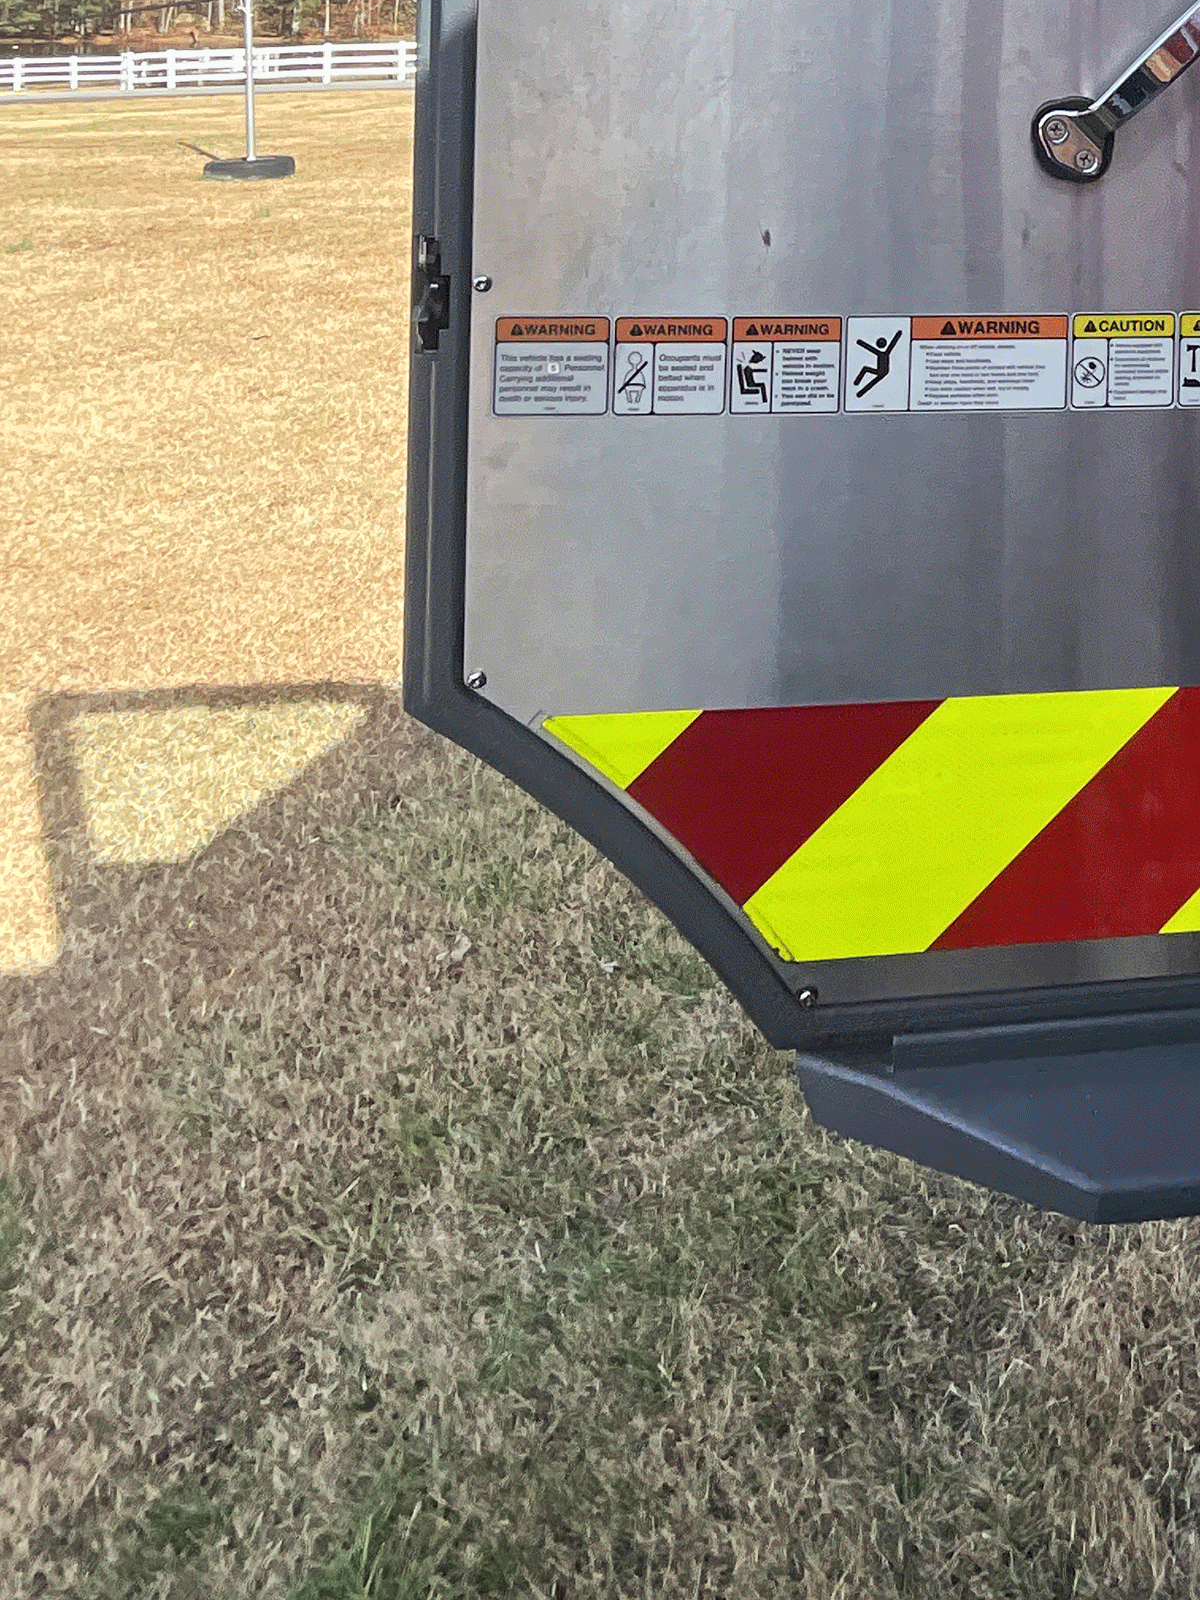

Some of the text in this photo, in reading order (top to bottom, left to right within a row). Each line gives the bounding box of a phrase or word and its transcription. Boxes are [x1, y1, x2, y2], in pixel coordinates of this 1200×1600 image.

[525, 324, 596, 335] WARNING
[644, 325, 713, 335] WARNING
[760, 324, 829, 335] WARNING
[958, 321, 1040, 334] WARNING
[1099, 320, 1165, 332] CAUTION
[659, 354, 700, 362] Occupants
[500, 375, 533, 383] Carrying
